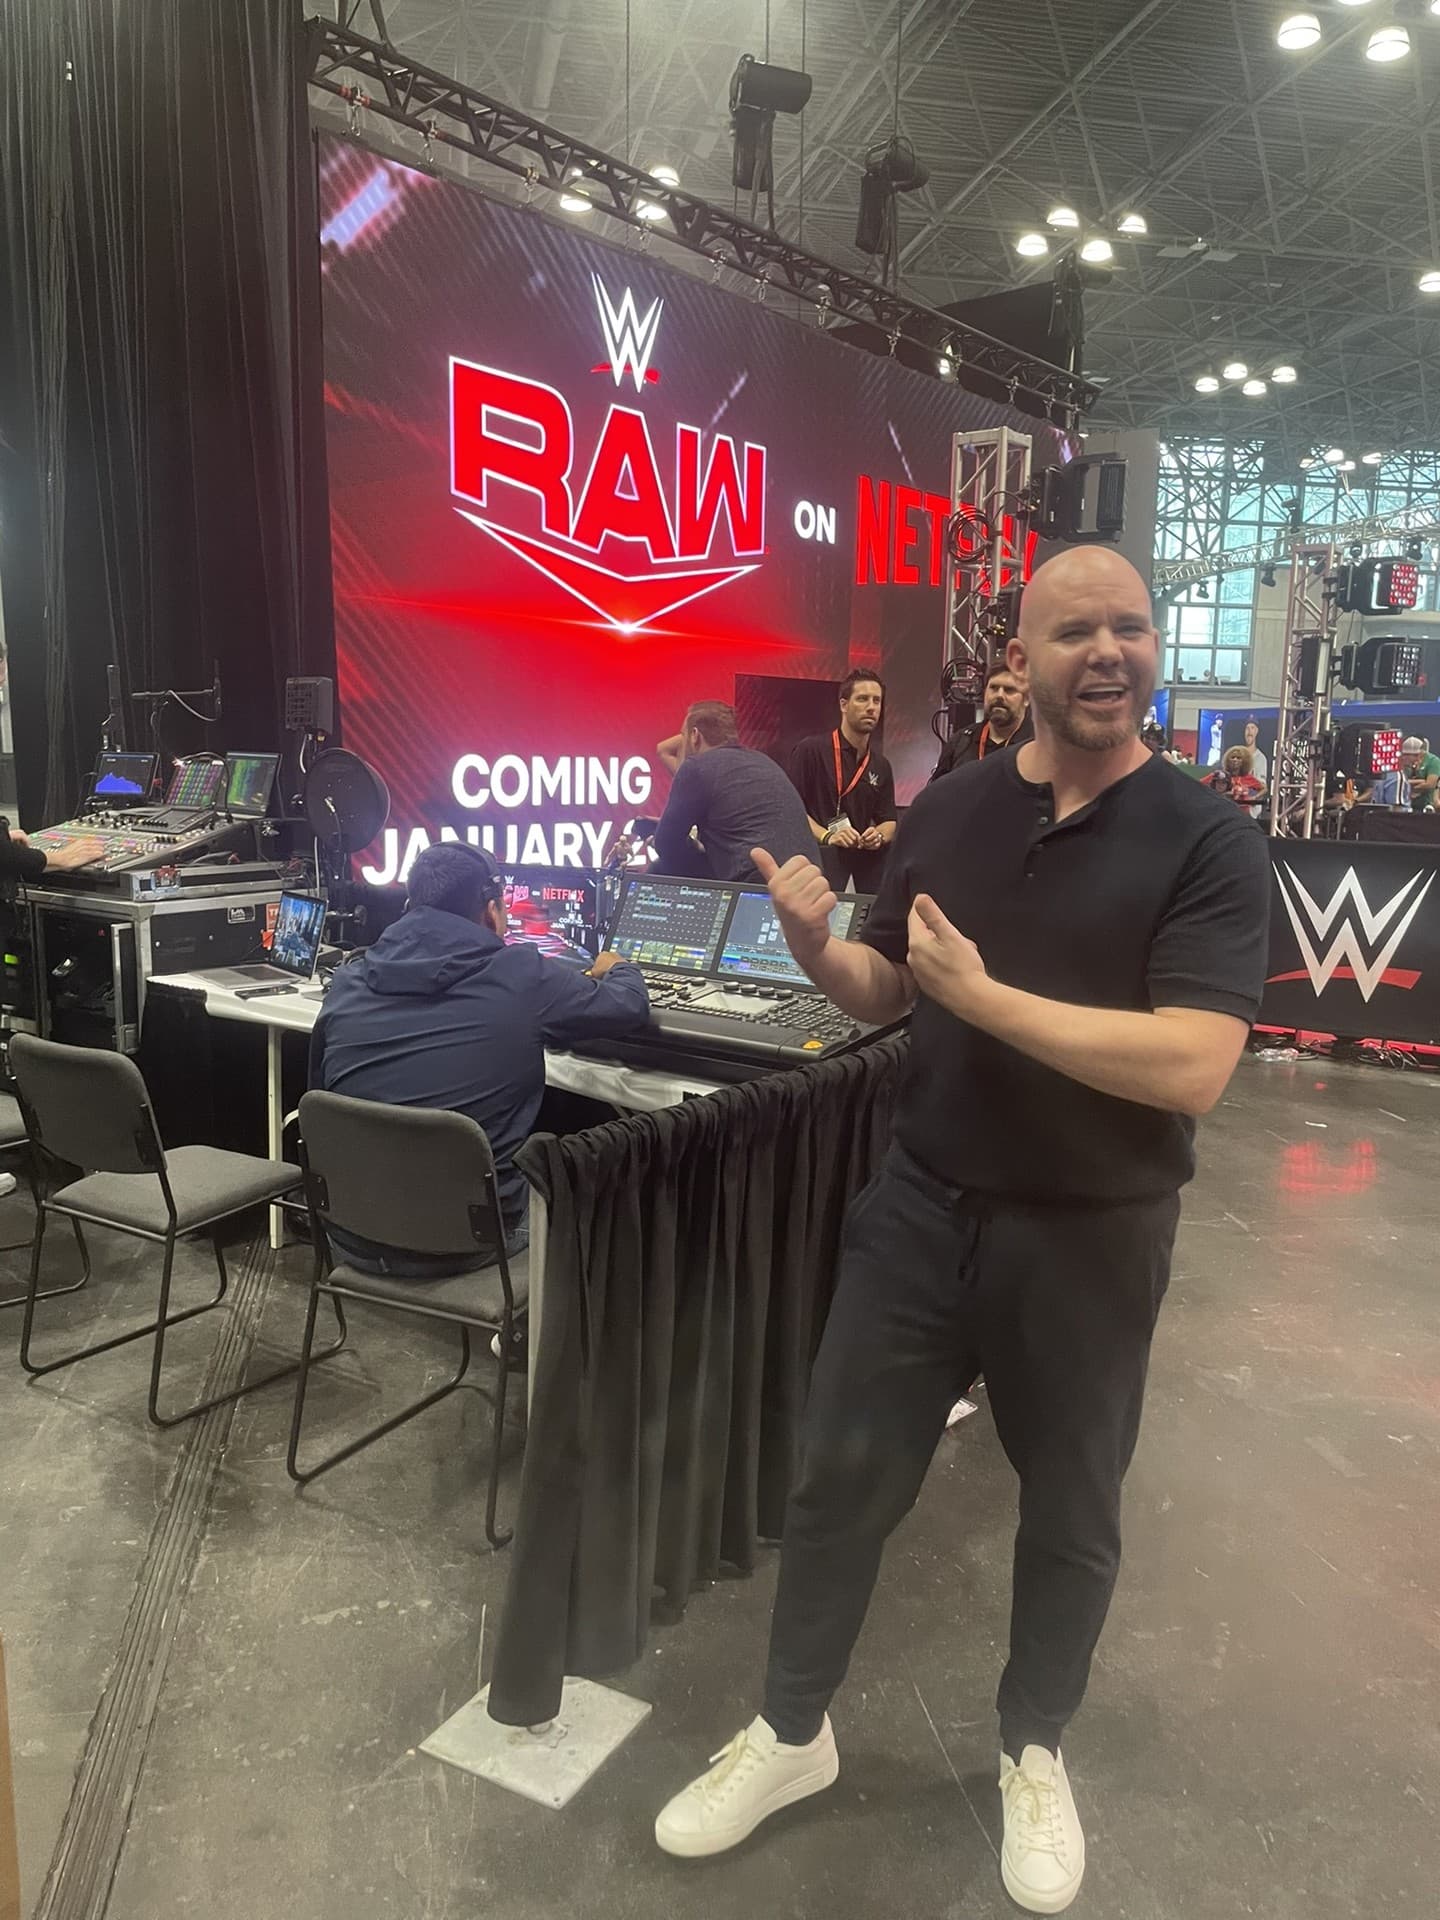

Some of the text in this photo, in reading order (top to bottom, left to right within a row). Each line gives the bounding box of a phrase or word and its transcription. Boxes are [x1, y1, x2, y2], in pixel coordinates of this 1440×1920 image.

[449, 355, 768, 564] RAW
[793, 500, 837, 545] ON
[452, 753, 652, 809] COMING
[543, 887, 585, 903] NETFX
